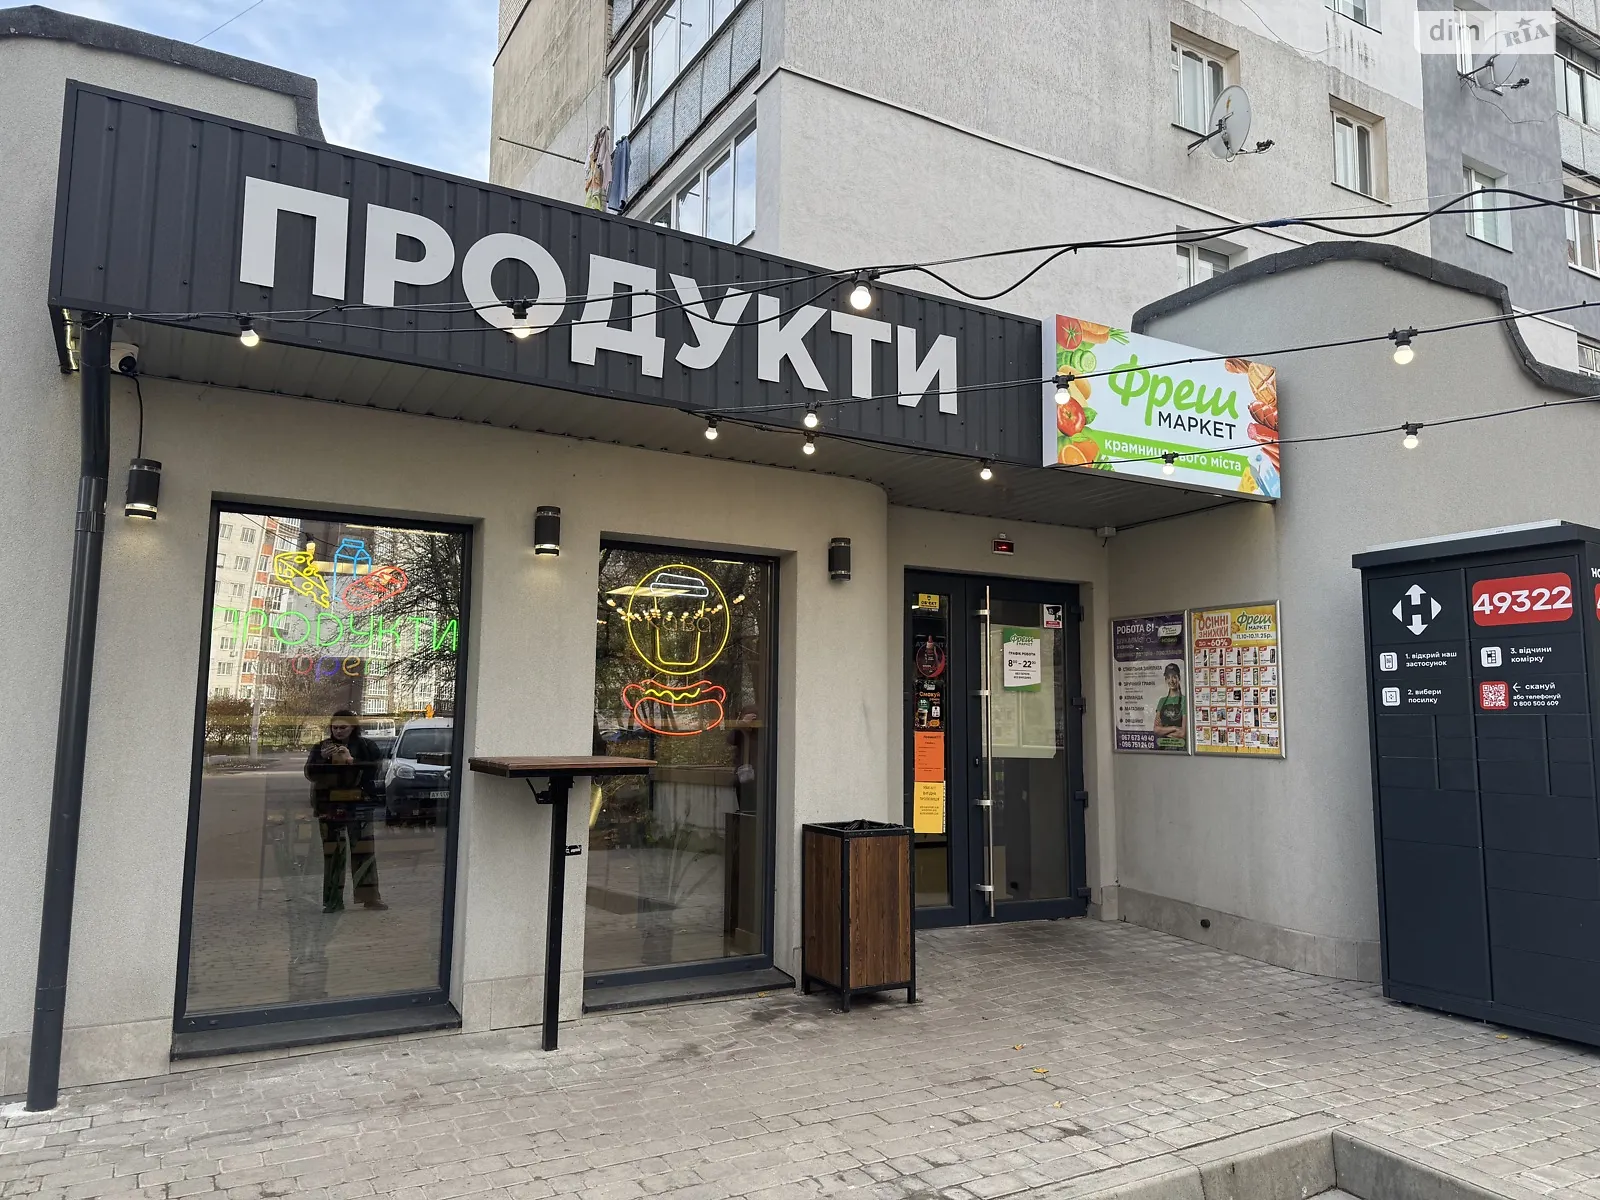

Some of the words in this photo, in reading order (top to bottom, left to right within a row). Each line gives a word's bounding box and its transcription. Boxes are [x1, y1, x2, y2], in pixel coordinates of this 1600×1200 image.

[239, 175, 958, 415] ПРОДУКТИ
[1107, 353, 1239, 427] Фреш
[1158, 410, 1236, 440] МАРКЕТ
[1173, 451, 1207, 465] вого
[1210, 455, 1241, 471] міста
[1472, 585, 1573, 615] 49322
[1198, 614, 1229, 631] ОСІННІ
[1237, 610, 1272, 631] Фреш
[1116, 625, 1145, 635] РОБОТА
[1146, 623, 1155, 632] Є!
[1198, 626, 1229, 638] ЗНИЖКИ
[1207, 639, 1228, 647] -60%
[1411, 651, 1440, 660] відкрий
[1441, 651, 1457, 659] наш
[1518, 646, 1552, 655] відчини
[1405, 660, 1447, 668] застосунок
[1511, 655, 1544, 664] комірку
[1415, 688, 1442, 696] вибери
[1525, 681, 1556, 691] скануй
[1526, 693, 1562, 702] телефонуй
